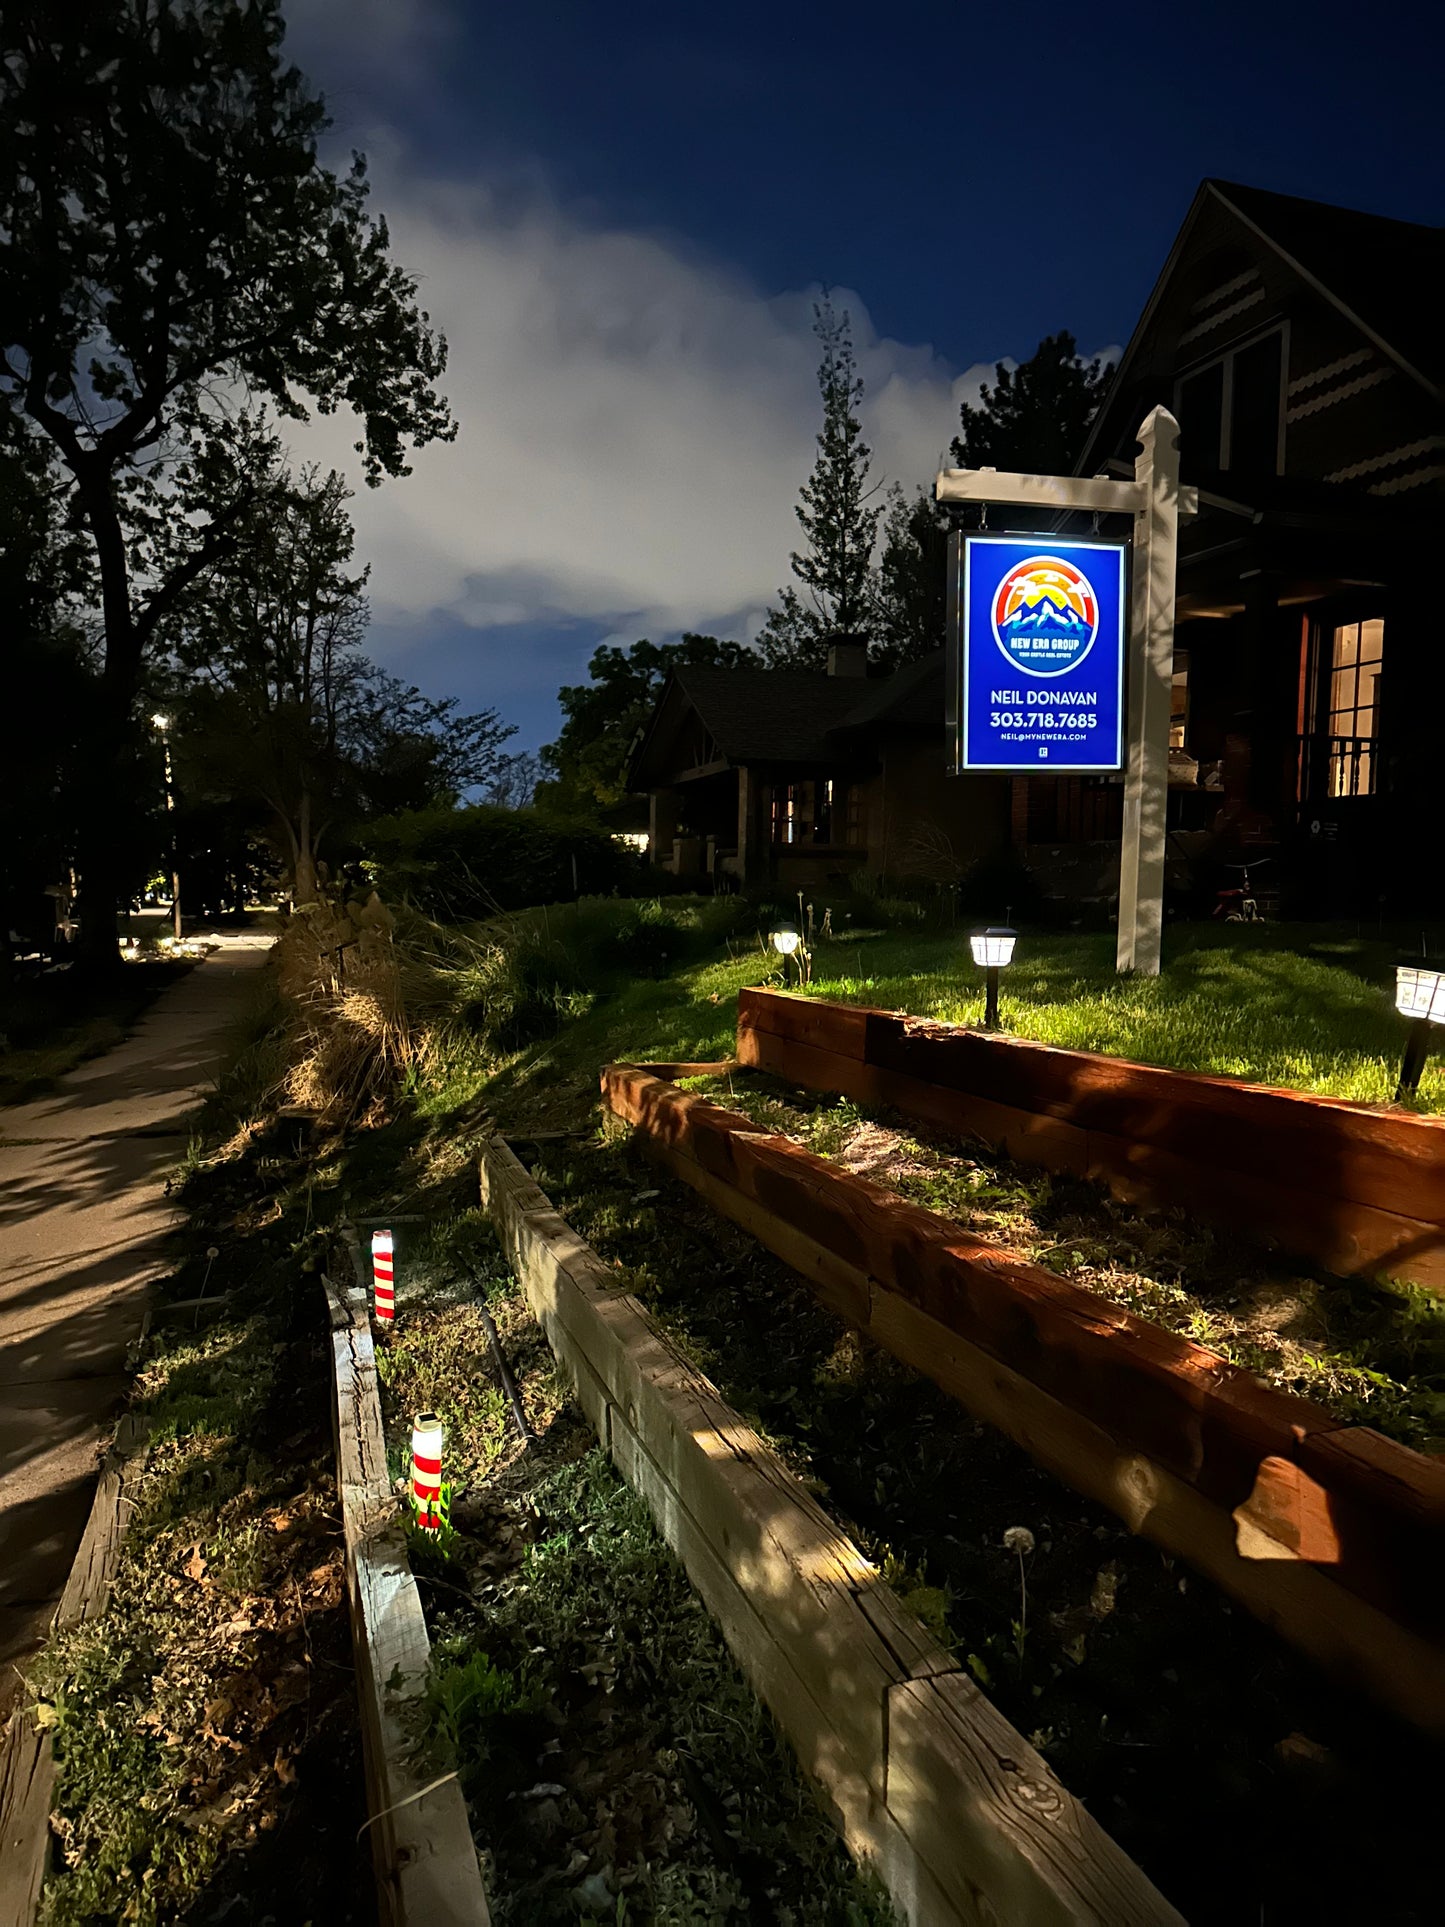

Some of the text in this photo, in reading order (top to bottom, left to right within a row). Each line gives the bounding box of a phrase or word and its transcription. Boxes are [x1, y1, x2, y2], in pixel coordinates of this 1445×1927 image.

[1010, 637, 1080, 651] NEW ERA GROUP
[990, 689, 1097, 706] NEIL DONAVAN
[989, 711, 1098, 729] 303.718.7685
[1000, 733, 1087, 742] NEIL@MYNEWERA.COM
